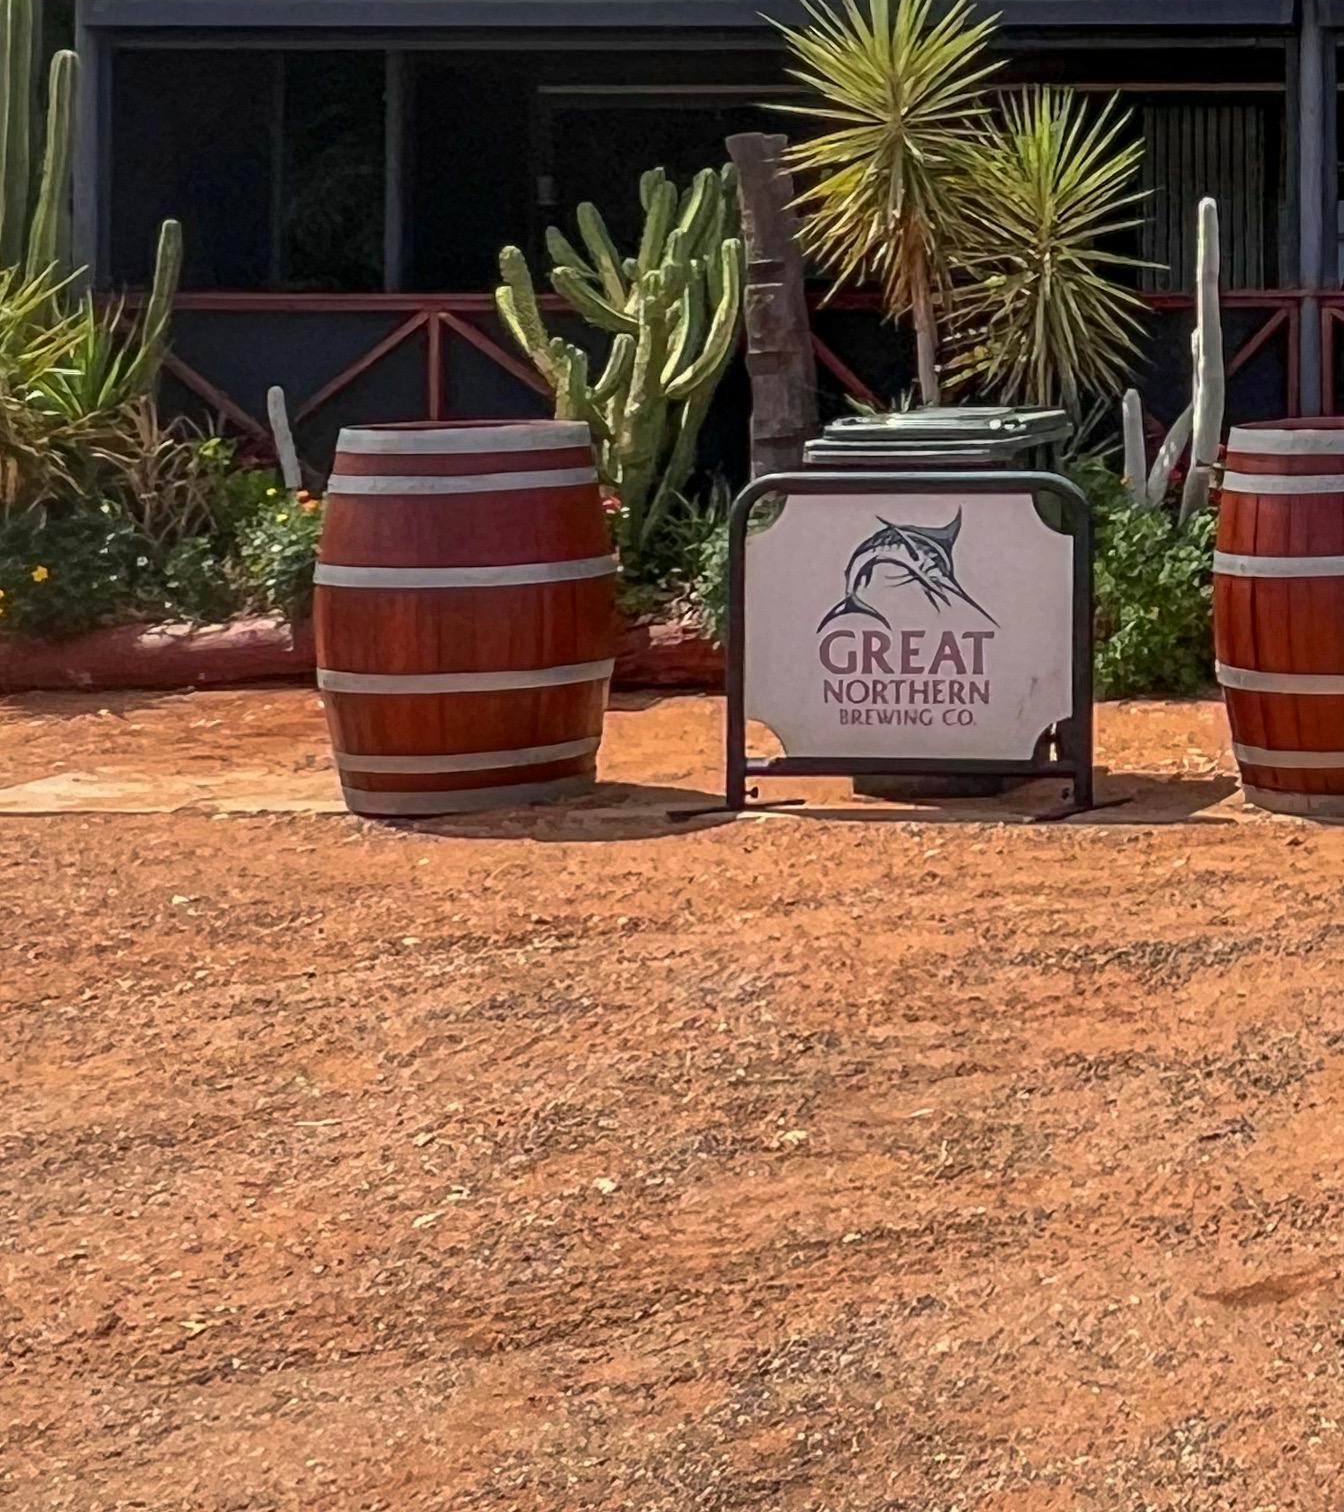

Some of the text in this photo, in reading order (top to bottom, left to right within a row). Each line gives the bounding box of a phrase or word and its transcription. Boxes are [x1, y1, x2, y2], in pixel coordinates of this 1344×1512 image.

[818, 629, 996, 676] GREAT
[822, 678, 991, 705] NORTHERN
[839, 708, 977, 727] BREWING CO.
